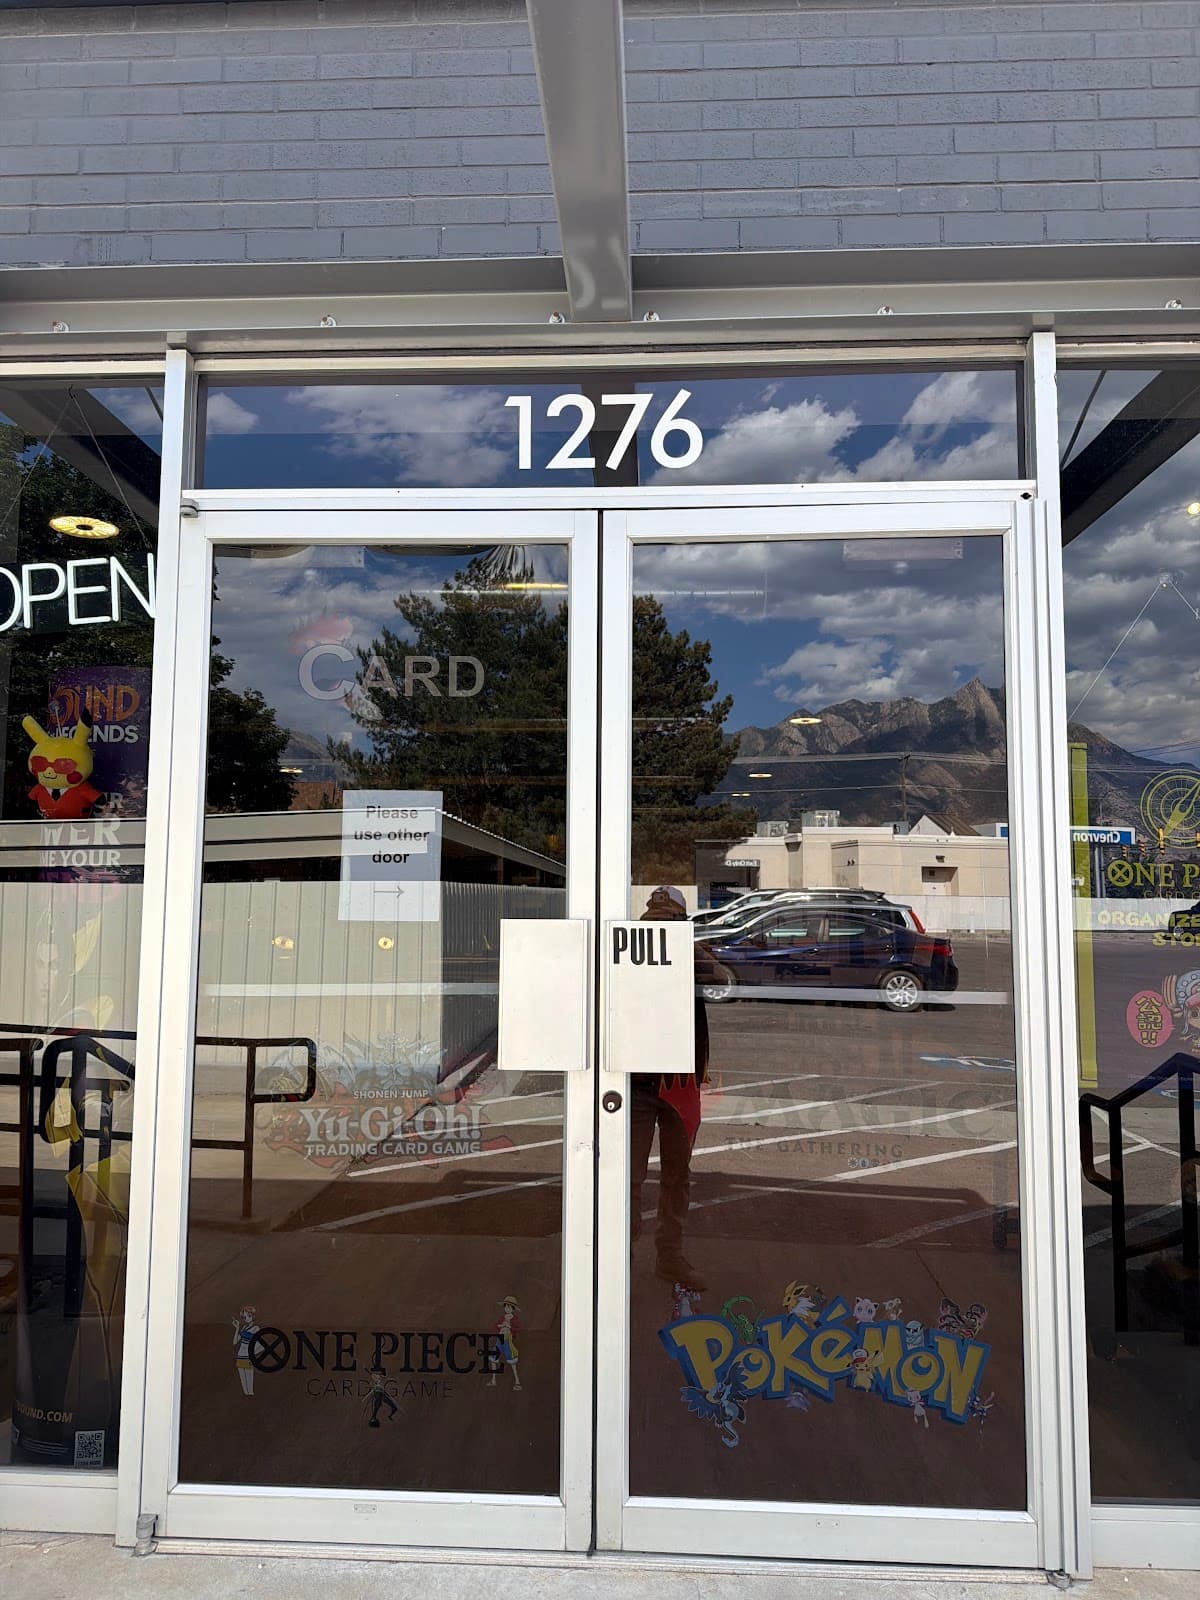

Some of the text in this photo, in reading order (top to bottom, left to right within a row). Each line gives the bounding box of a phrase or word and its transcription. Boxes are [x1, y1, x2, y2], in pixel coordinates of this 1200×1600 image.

[504, 388, 703, 471] 1276
[298, 644, 485, 700] CARD
[366, 805, 419, 820] Please
[354, 828, 430, 842] use other
[372, 851, 410, 864] door
[612, 926, 672, 966] PULL
[353, 1089, 430, 1099] SHONEN JUMP
[300, 1103, 486, 1143] Yu-Gi-Oh!
[304, 1141, 481, 1157] TRADING CARD GAME
[778, 1139, 904, 1159] GATHERING
[370, 1331, 505, 1375] PIECE
